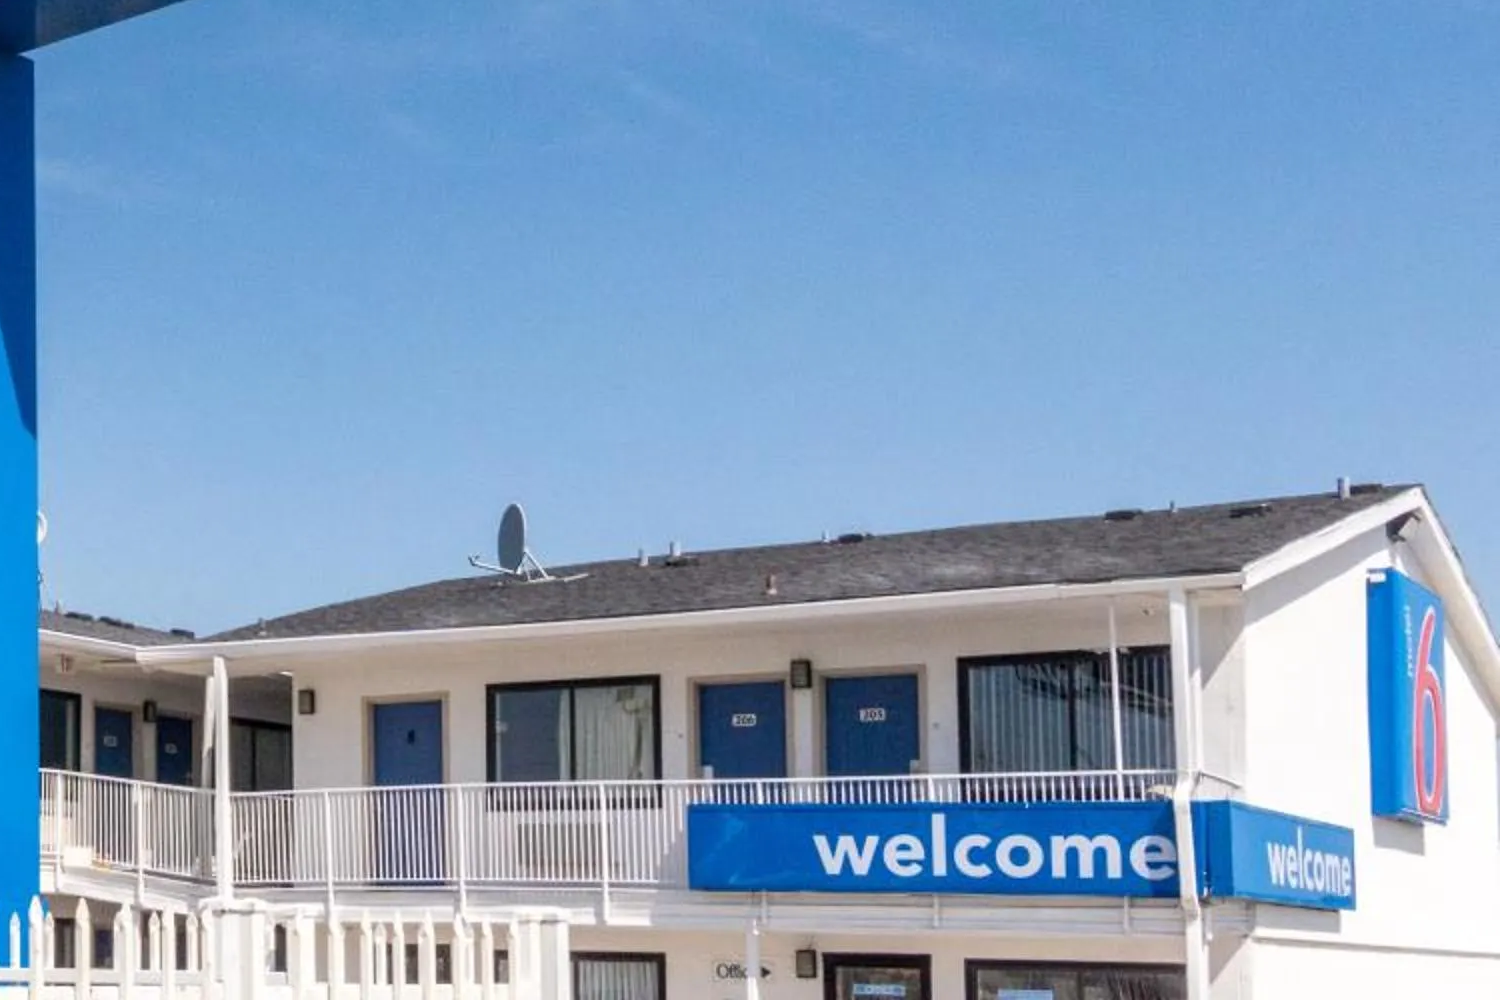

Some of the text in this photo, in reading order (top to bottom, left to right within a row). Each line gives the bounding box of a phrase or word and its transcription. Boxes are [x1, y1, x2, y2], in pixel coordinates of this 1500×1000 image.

[1413, 604, 1445, 816] 6
[813, 813, 1178, 881] welcome
[1266, 824, 1352, 897] welcome
